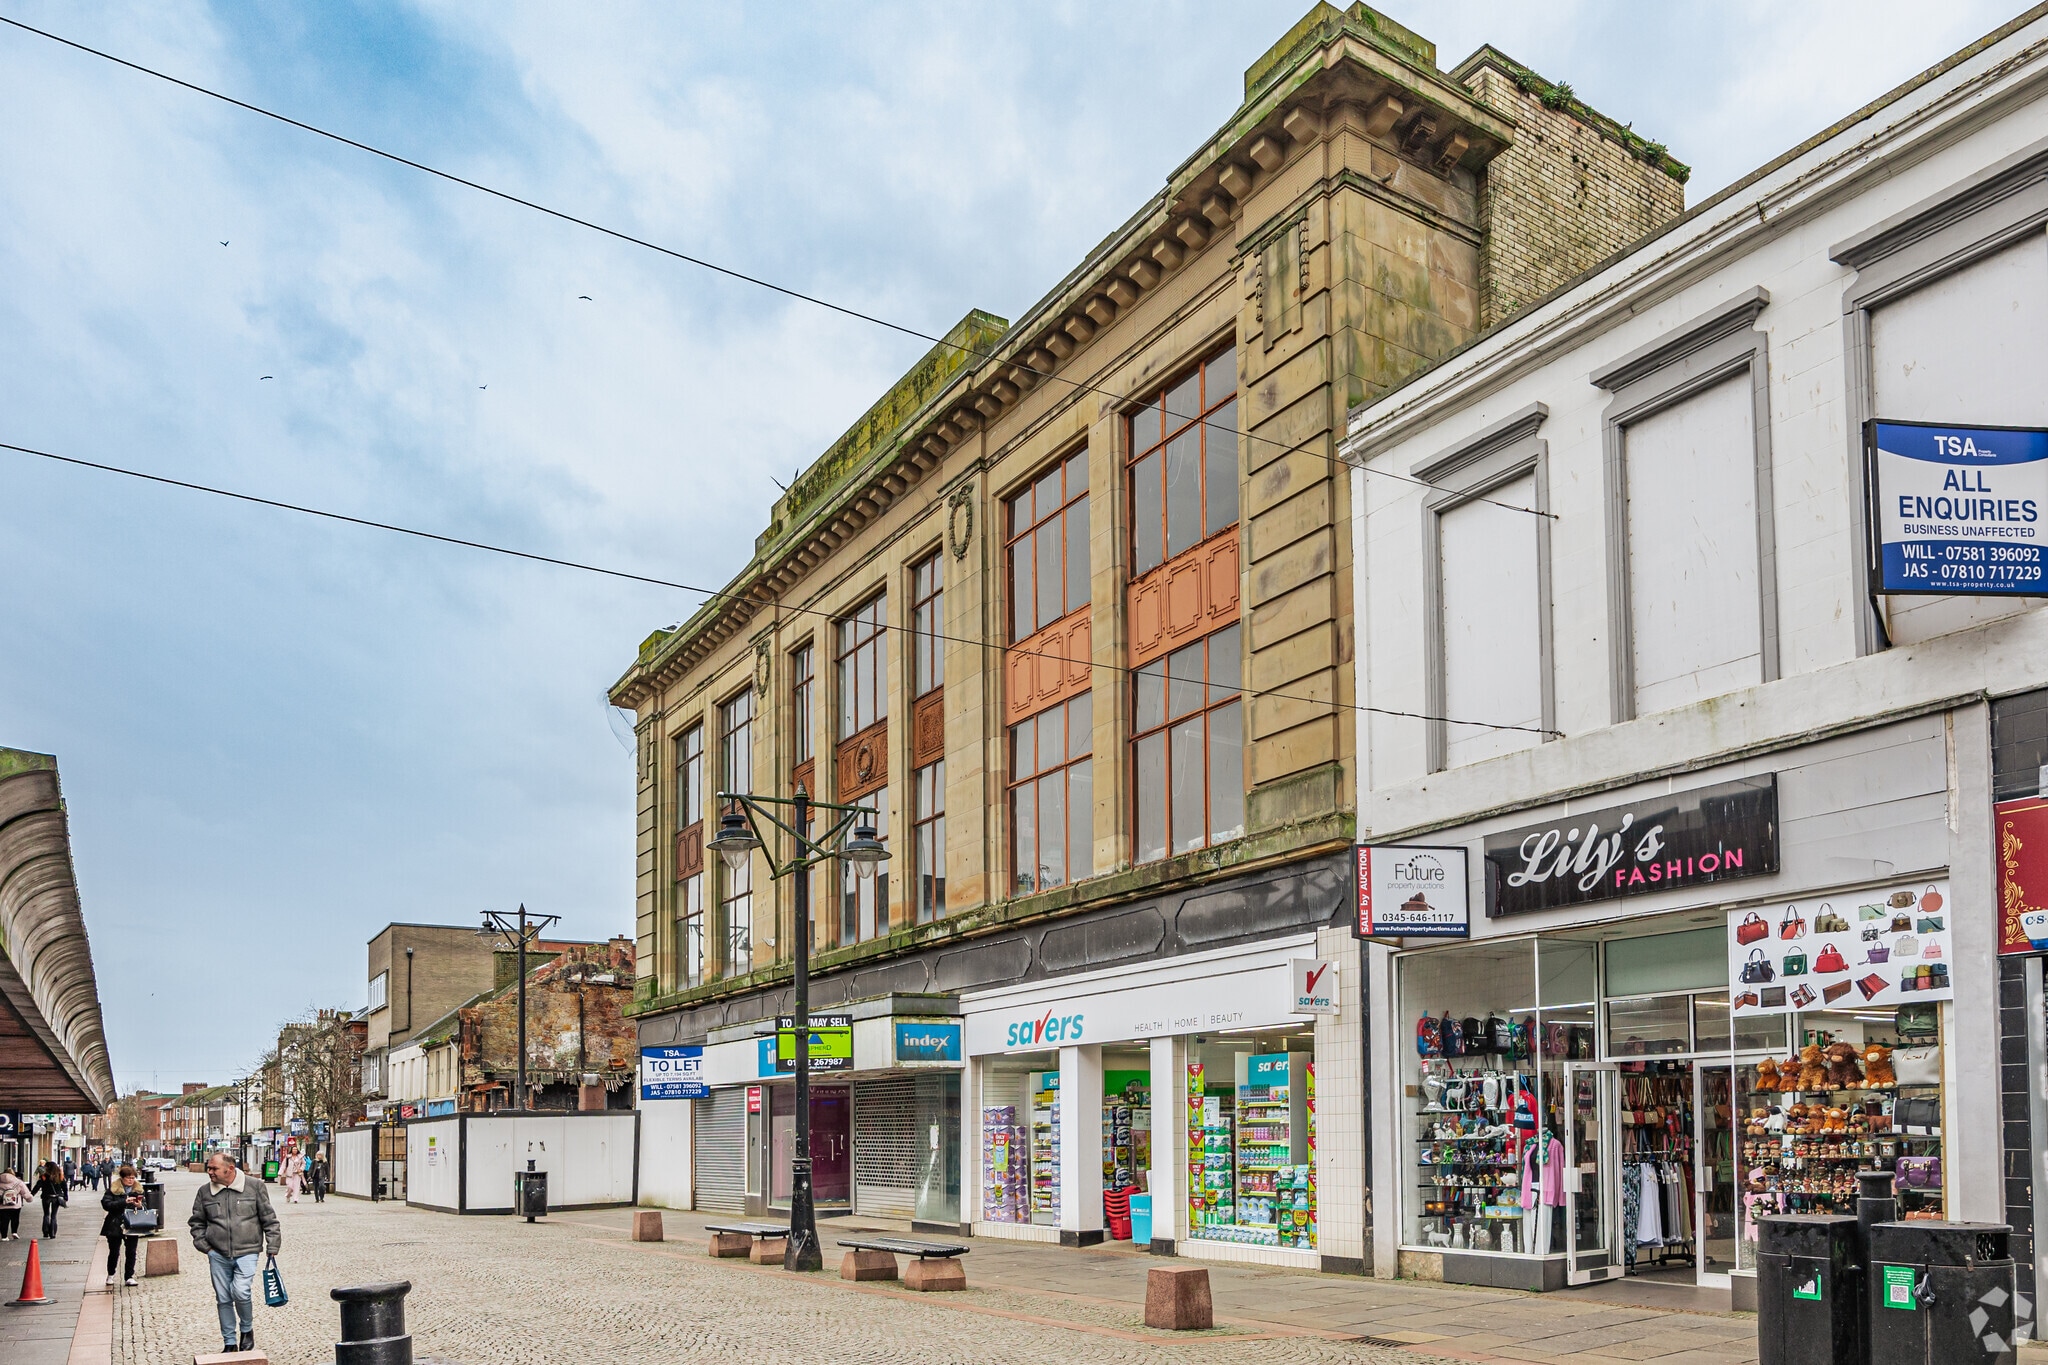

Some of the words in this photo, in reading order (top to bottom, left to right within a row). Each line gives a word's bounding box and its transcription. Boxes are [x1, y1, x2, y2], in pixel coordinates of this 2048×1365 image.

[1934, 435, 1978, 457] TSA
[1943, 469, 1992, 493] ALL
[1899, 495, 2038, 523] ENQUIRIES
[1904, 523, 1959, 536] BUSINESS
[1962, 525, 2035, 538] UNAFFECTED
[1902, 543, 1936, 560] WILL
[1946, 545, 1986, 561] 07581
[1990, 547, 2041, 562] 396092
[1903, 562, 1929, 578] JAS
[1941, 564, 1985, 579] 07810
[1989, 565, 2042, 580] 717229
[1930, 581, 2015, 589] www.tsa-property.co.uk
[1507, 812, 1665, 892] Lily's
[1359, 849, 1368, 891] AUCTION
[1394, 863, 1445, 881] Future
[1615, 847, 1744, 888] FASHION
[1387, 882, 1415, 890] property
[1416, 882, 1445, 890] auctions
[1360, 893, 1370, 906] by
[1361, 909, 1369, 933] SALE
[1382, 913, 1455, 922] 0345-646-1117
[1298, 995, 1330, 1006] savers
[781, 1018, 792, 1028] TO
[830, 1017, 849, 1027] SELL
[1006, 1008, 1084, 1047] savers
[1134, 1021, 1163, 1032] HEALTH
[1174, 1017, 1198, 1028] HOME
[1210, 1012, 1243, 1025] BEAUTY
[904, 1032, 951, 1052] index
[649, 1060, 670, 1072] TO
[674, 1059, 702, 1072] LET
[813, 1058, 844, 1067] 267987
[267, 1272, 280, 1299] RNLI
